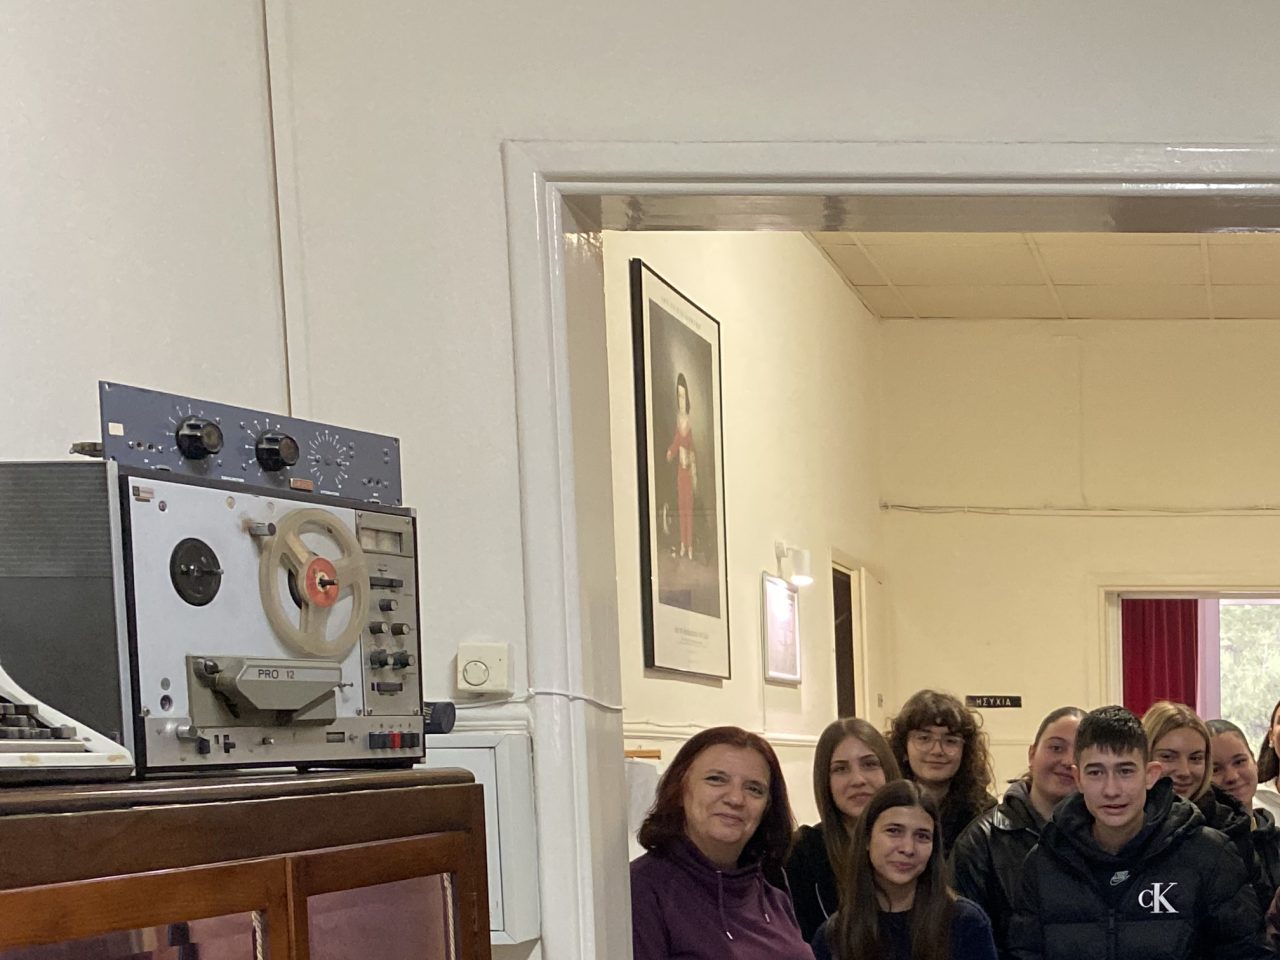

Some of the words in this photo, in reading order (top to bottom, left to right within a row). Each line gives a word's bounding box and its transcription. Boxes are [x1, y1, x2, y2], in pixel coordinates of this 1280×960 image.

[257, 669, 279, 680] PRO
[286, 670, 295, 680] 12
[976, 697, 1012, 707] ΗΣΥΧΙΑ
